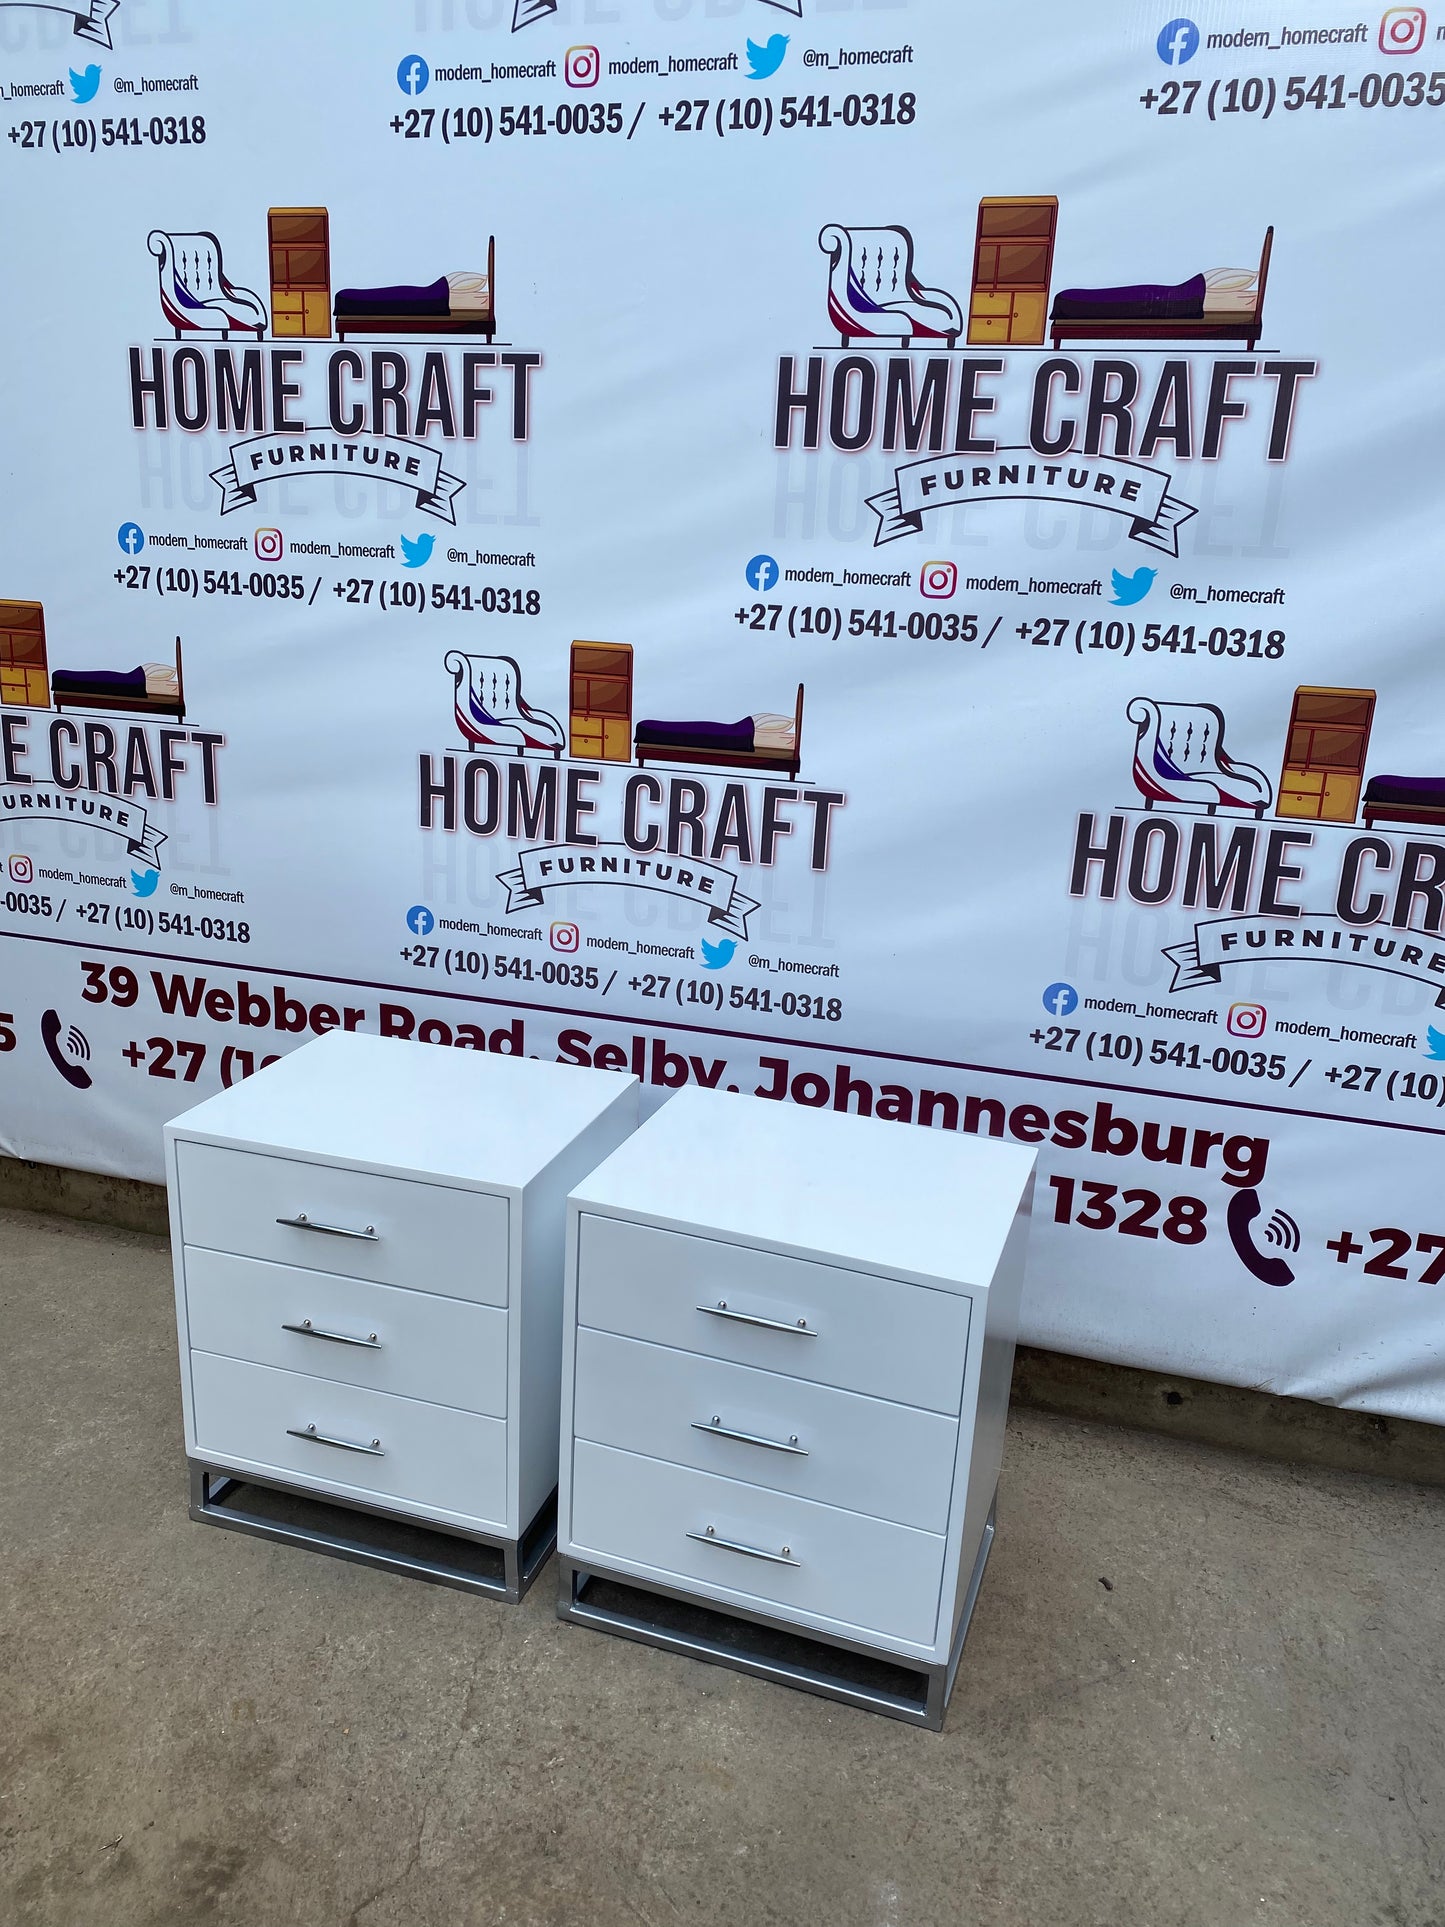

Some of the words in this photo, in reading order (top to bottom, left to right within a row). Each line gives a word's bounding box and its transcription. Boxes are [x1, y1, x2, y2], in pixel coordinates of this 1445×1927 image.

[803, 45, 914, 70] @m_homecraft
[113, 76, 199, 96] @m_homecraft
[1140, 80, 1201, 114] +27
[1208, 78, 1276, 120] (10)
[1283, 71, 1445, 110] 541-0035
[8, 120, 46, 148] +27
[52, 118, 97, 153] (10)
[101, 116, 206, 148] 541-0318
[389, 108, 435, 139] +27
[441, 107, 493, 144] (10)
[499, 104, 623, 136] 541-0035
[658, 100, 709, 132] +27
[715, 97, 773, 137] (10)
[779, 92, 916, 129] 541-0318
[128, 346, 304, 434] HOME
[326, 349, 542, 441] CRAFT
[773, 355, 1003, 454] HOME
[1028, 357, 1317, 462] CRAFT
[250, 443, 420, 476] FURNITURE
[921, 465, 1141, 502] FURNITURE
[447, 549, 536, 567] @m_homecraft
[114, 566, 151, 589] +27
[157, 567, 198, 598] (10)
[204, 571, 304, 600] 541-0035
[333, 578, 374, 604] +27
[380, 581, 425, 611] (10)
[431, 585, 541, 616] 541-0318
[1170, 583, 1286, 607] @m_homecraft
[734, 605, 783, 631] +27
[788, 606, 842, 639] (10)
[848, 609, 978, 643] 541-0035
[1015, 619, 1069, 646] +27
[1075, 621, 1134, 658] (10)
[1141, 624, 1286, 661] 541-0318
[49, 718, 226, 806] CRAFT
[418, 752, 603, 848] HOME
[622, 774, 847, 872] CRAFT
[540, 856, 716, 895] FURNITURE
[1068, 811, 1313, 919] HOME
[169, 882, 245, 904] @m_homecraft
[75, 903, 110, 925] +27
[115, 905, 154, 936] (10)
[158, 911, 251, 944] 541-0318
[748, 955, 840, 978] @m_homecraft
[1221, 928, 1445, 974] FURNITURE
[400, 944, 440, 970] +27
[444, 949, 489, 981] (10)
[494, 956, 599, 990] 541-0035
[628, 974, 672, 1001] +27
[676, 979, 724, 1011] (10)
[729, 985, 843, 1022] 541-0318
[81, 960, 139, 1008] 39
[149, 970, 366, 1037] Webber
[754, 1056, 1270, 1188] Johannesburg
[122, 1036, 207, 1083] +27
[1029, 1026, 1081, 1053] +27
[1085, 1032, 1143, 1066] (10)
[1149, 1040, 1286, 1080] 541-0035
[1324, 1064, 1382, 1093] +27
[1049, 1174, 1208, 1246] 1328
[1326, 1226, 1445, 1286] +27
